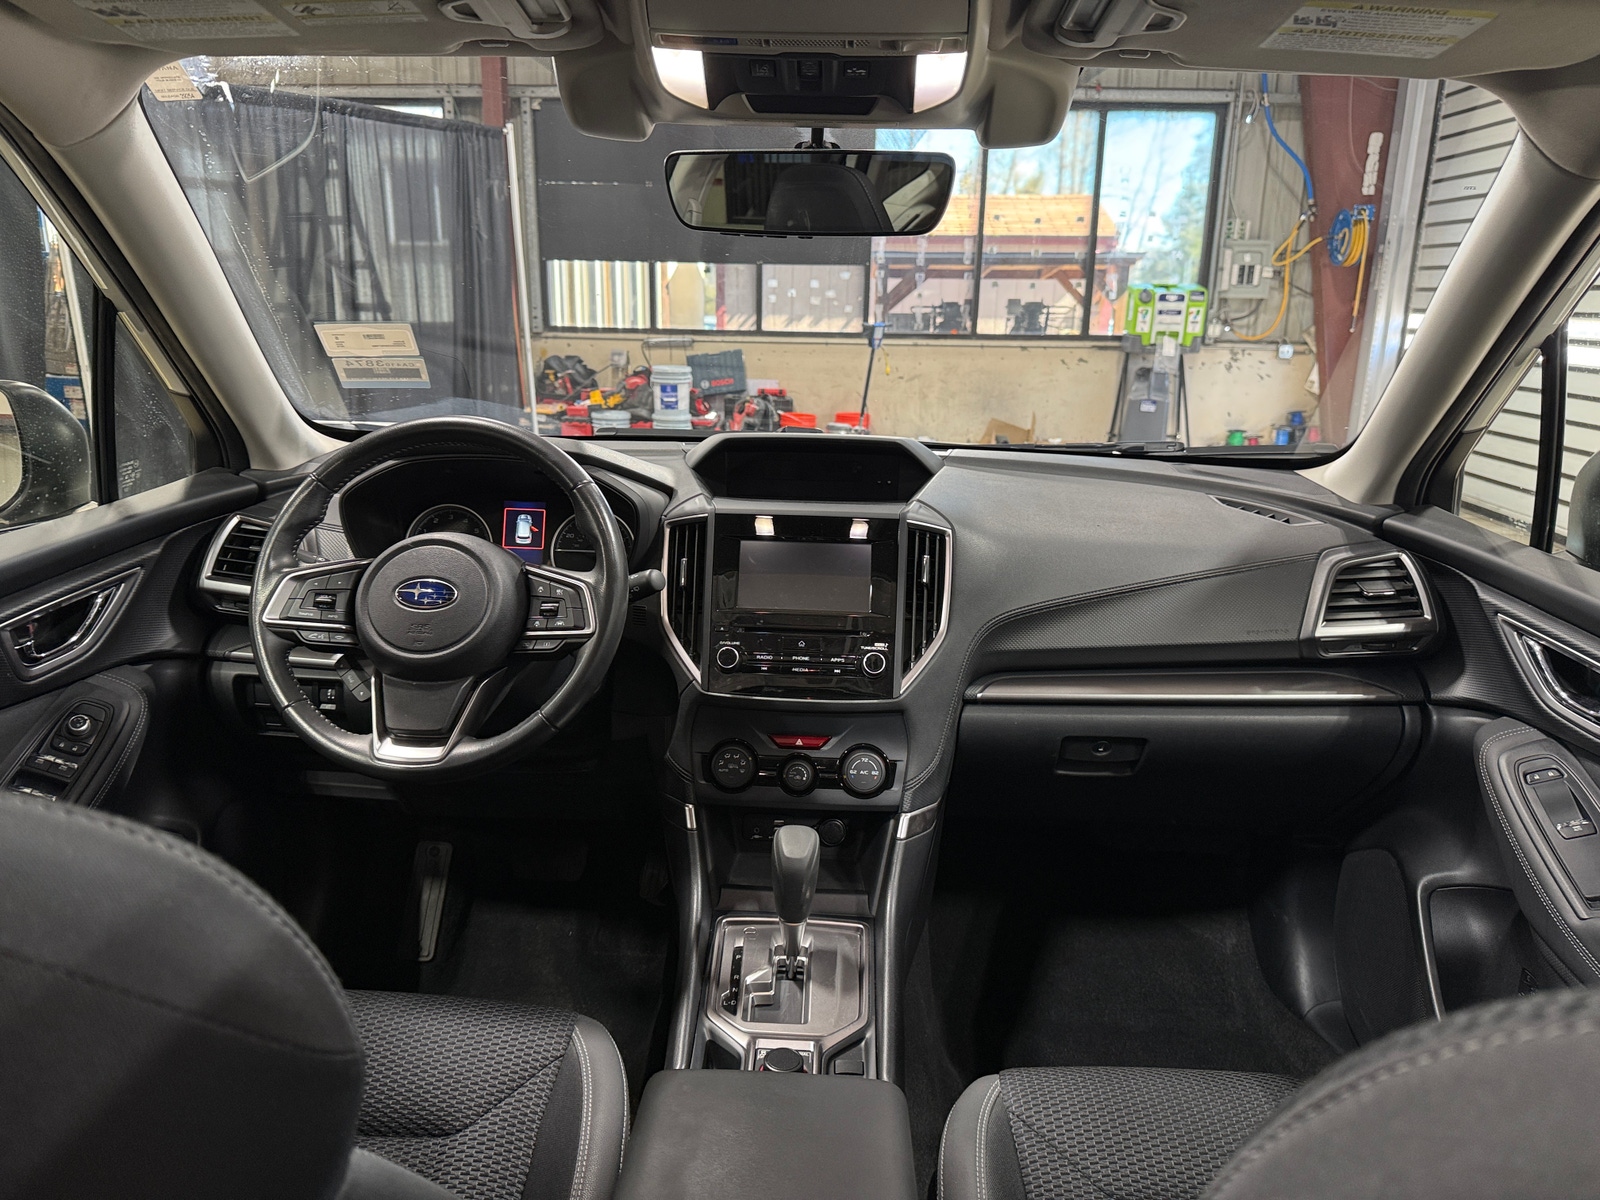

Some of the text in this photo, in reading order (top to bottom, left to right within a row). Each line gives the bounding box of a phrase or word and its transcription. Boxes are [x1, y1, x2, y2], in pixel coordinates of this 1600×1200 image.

[1368, 4, 1450, 15] WARNING
[1307, 28, 1449, 43] AVERTISSEMENT
[711, 378, 734, 387] BOSCH
